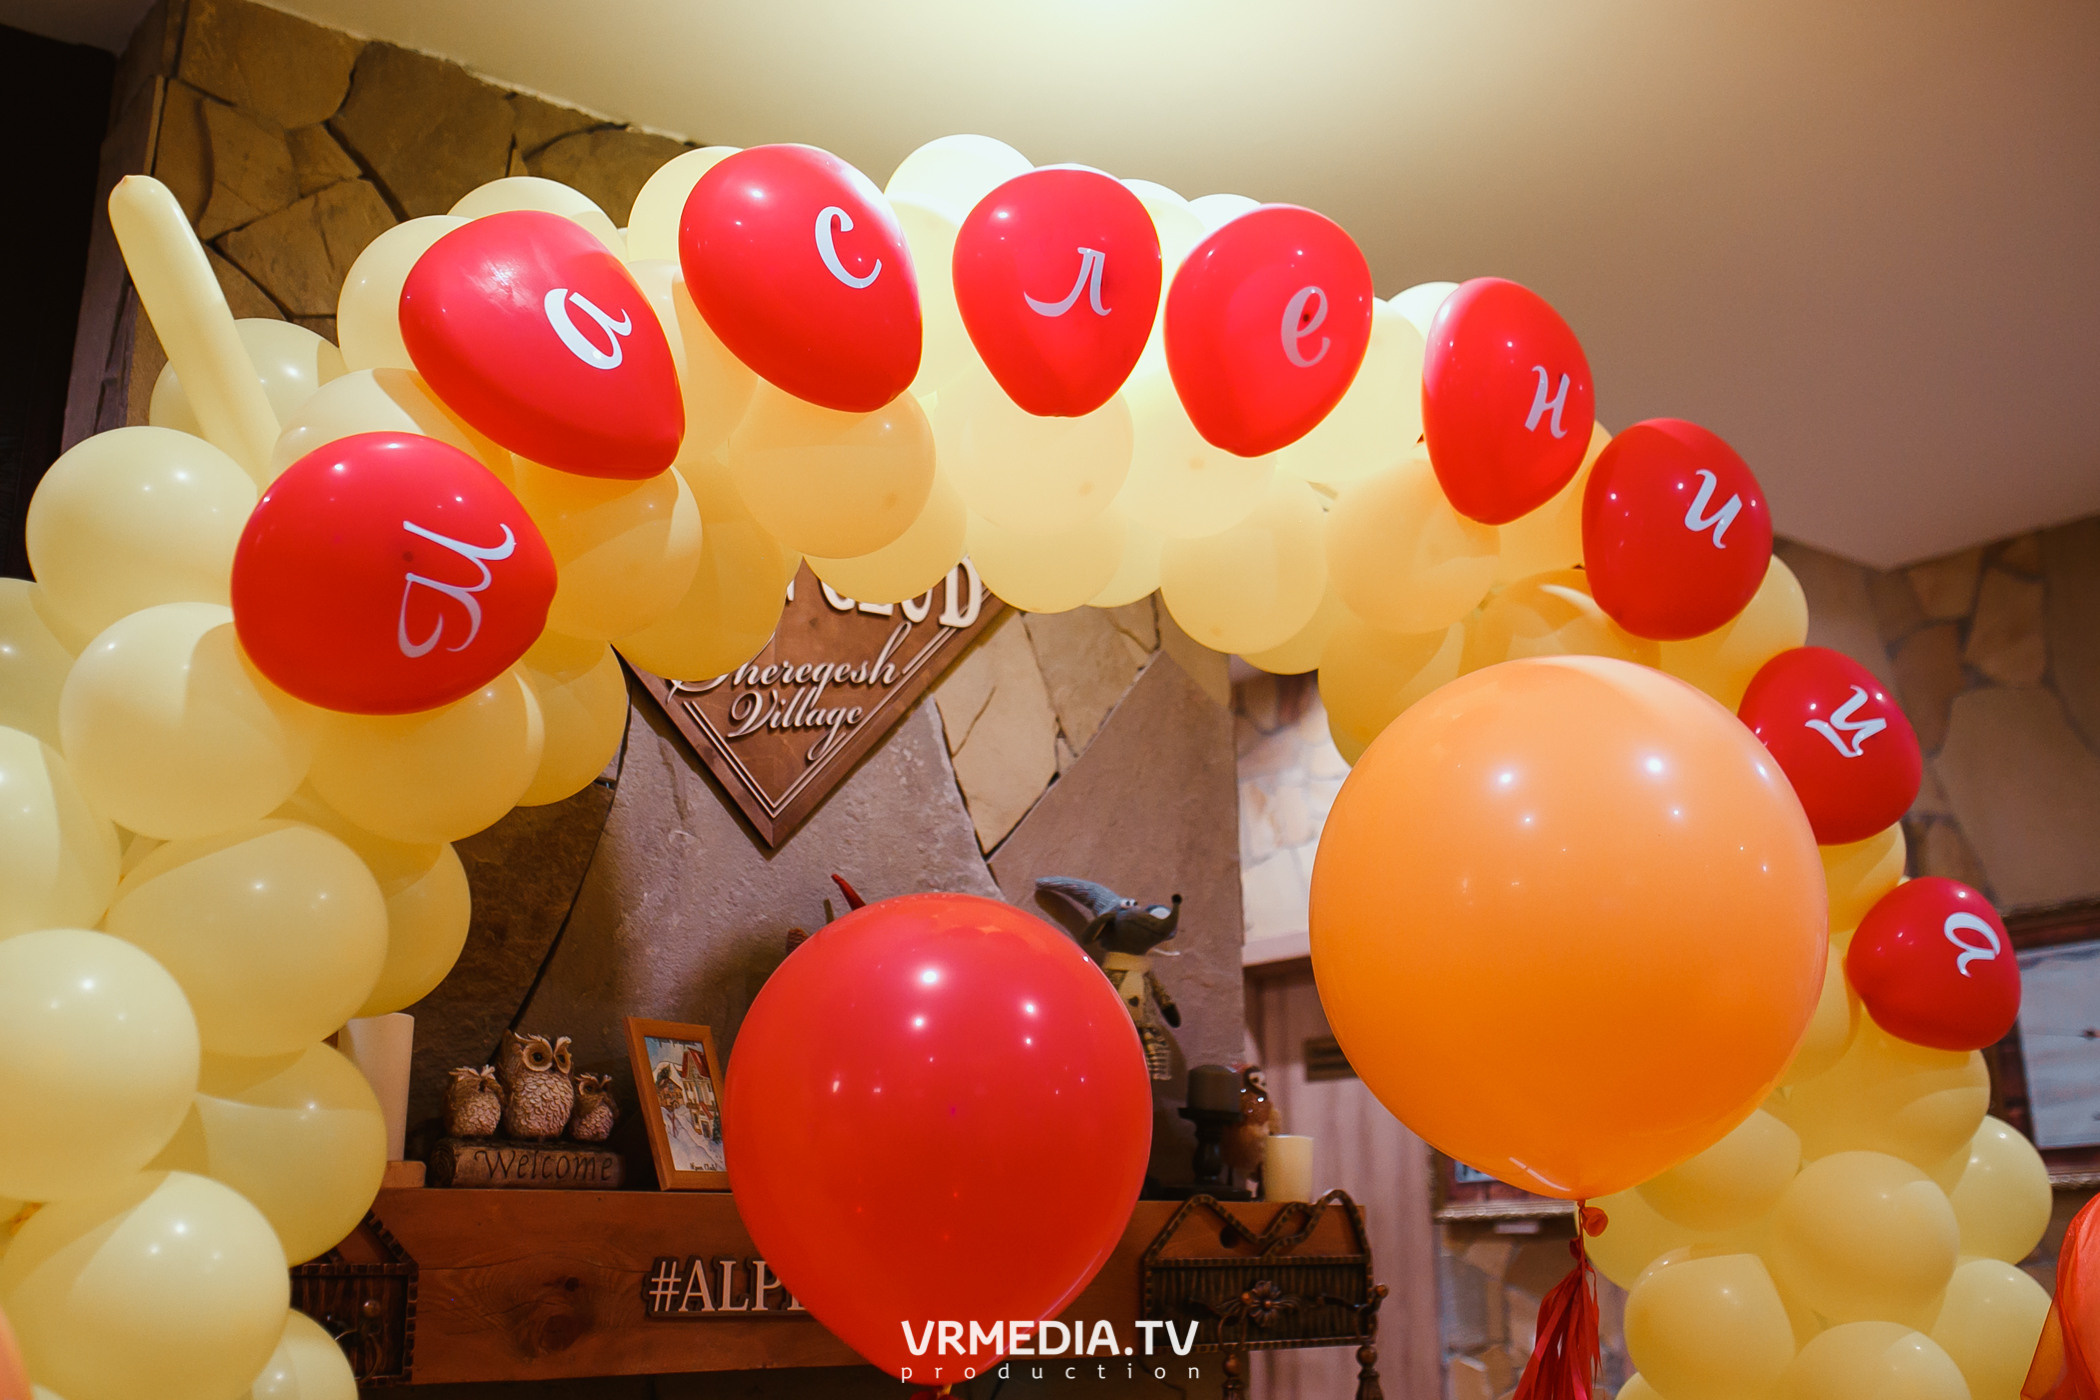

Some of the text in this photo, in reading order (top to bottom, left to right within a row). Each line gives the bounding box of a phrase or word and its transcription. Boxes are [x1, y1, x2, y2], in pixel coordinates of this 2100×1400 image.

[727, 687, 864, 762] Village
[474, 1150, 613, 1181] Welcome
[649, 1258, 807, 1312] #ALP
